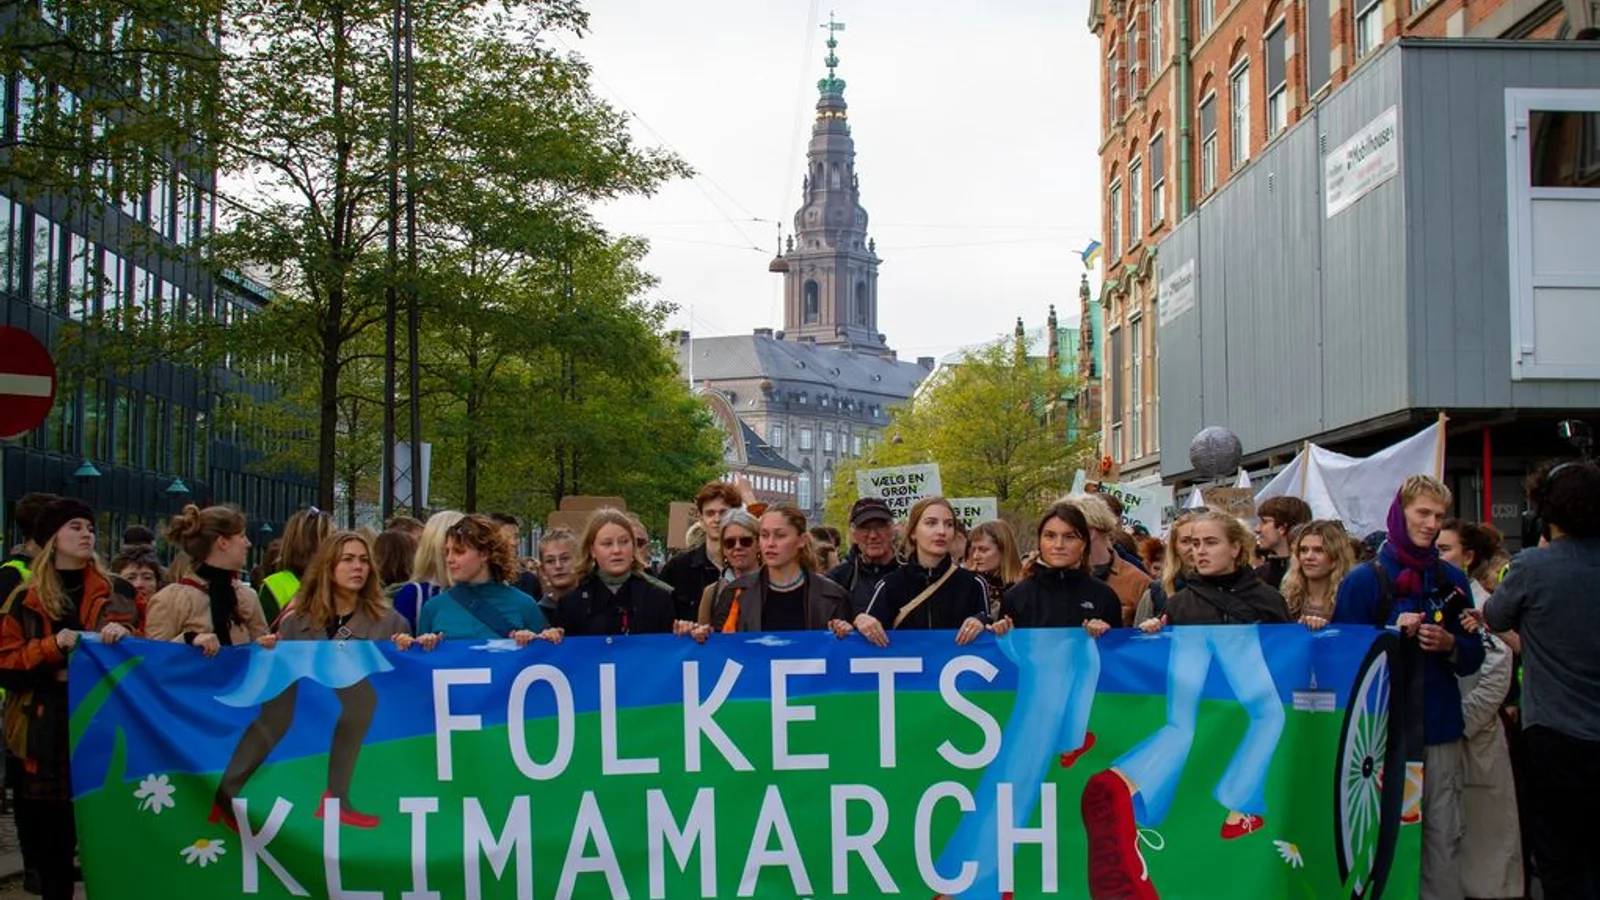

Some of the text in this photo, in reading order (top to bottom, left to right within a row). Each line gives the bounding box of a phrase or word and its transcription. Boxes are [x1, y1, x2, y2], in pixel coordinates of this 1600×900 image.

[871, 473, 925, 487] VÆLG EN
[881, 485, 918, 497] GRØN
[1125, 493, 1142, 506] EN
[964, 506, 981, 516] EN
[432, 655, 1002, 781] FOLKETS
[231, 781, 1059, 900] KLIMAMARCH
